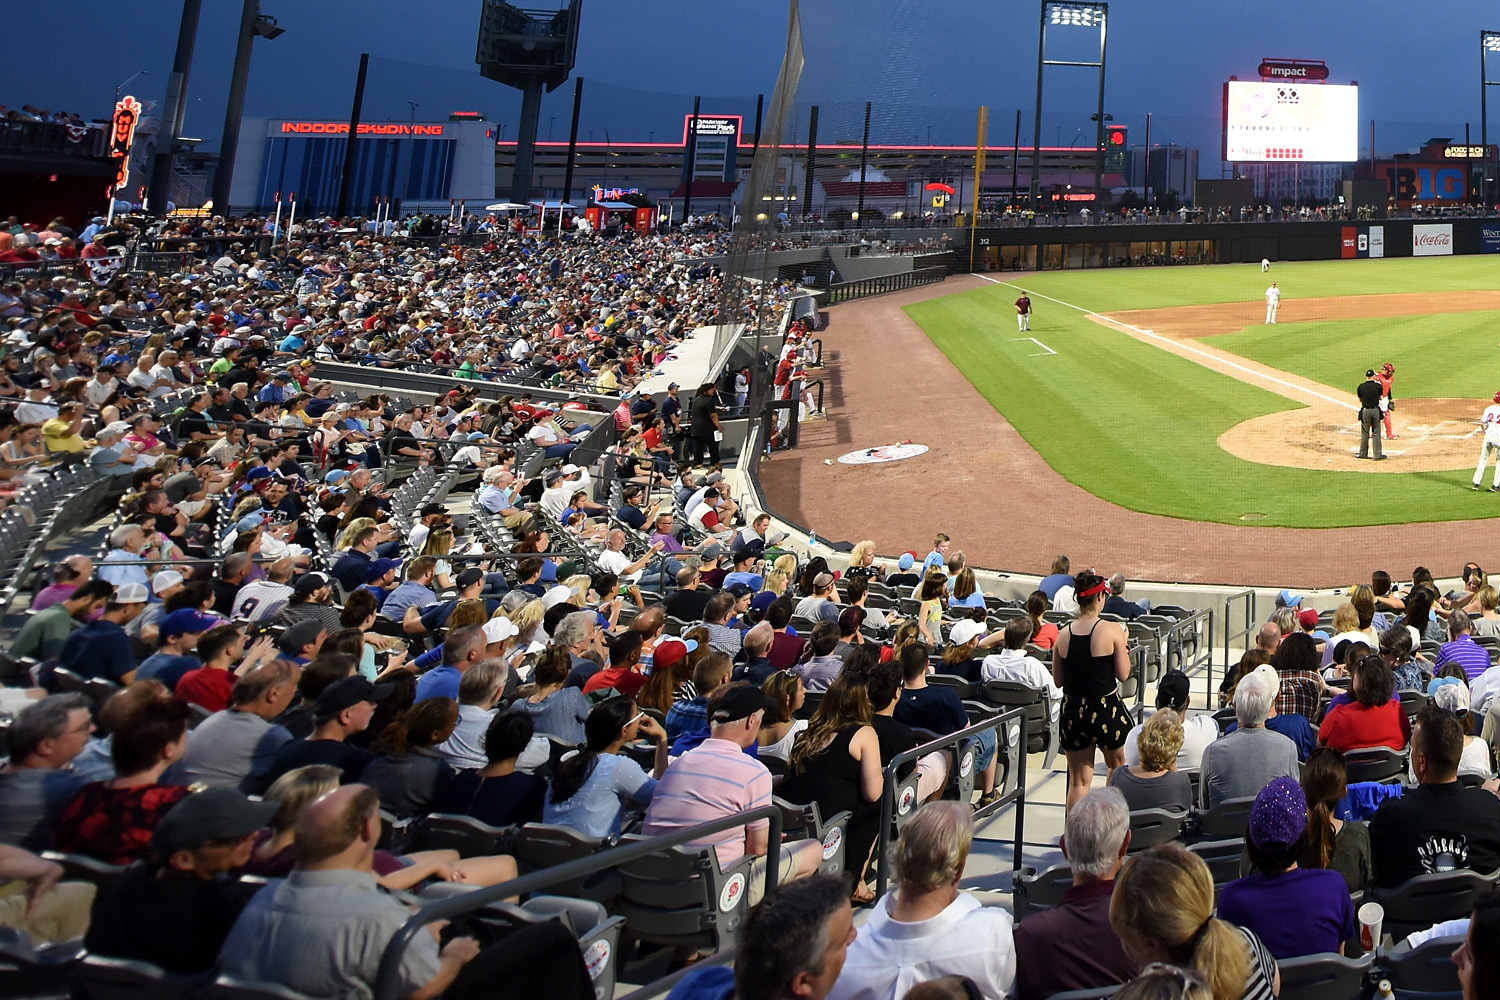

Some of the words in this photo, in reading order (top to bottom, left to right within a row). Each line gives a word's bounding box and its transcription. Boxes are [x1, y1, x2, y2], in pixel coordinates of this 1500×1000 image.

[1271, 66, 1306, 77] impact
[281, 122, 350, 134] INDOOR
[356, 124, 443, 136] SKYDIVING
[1417, 837, 1470, 859] RELEASE
